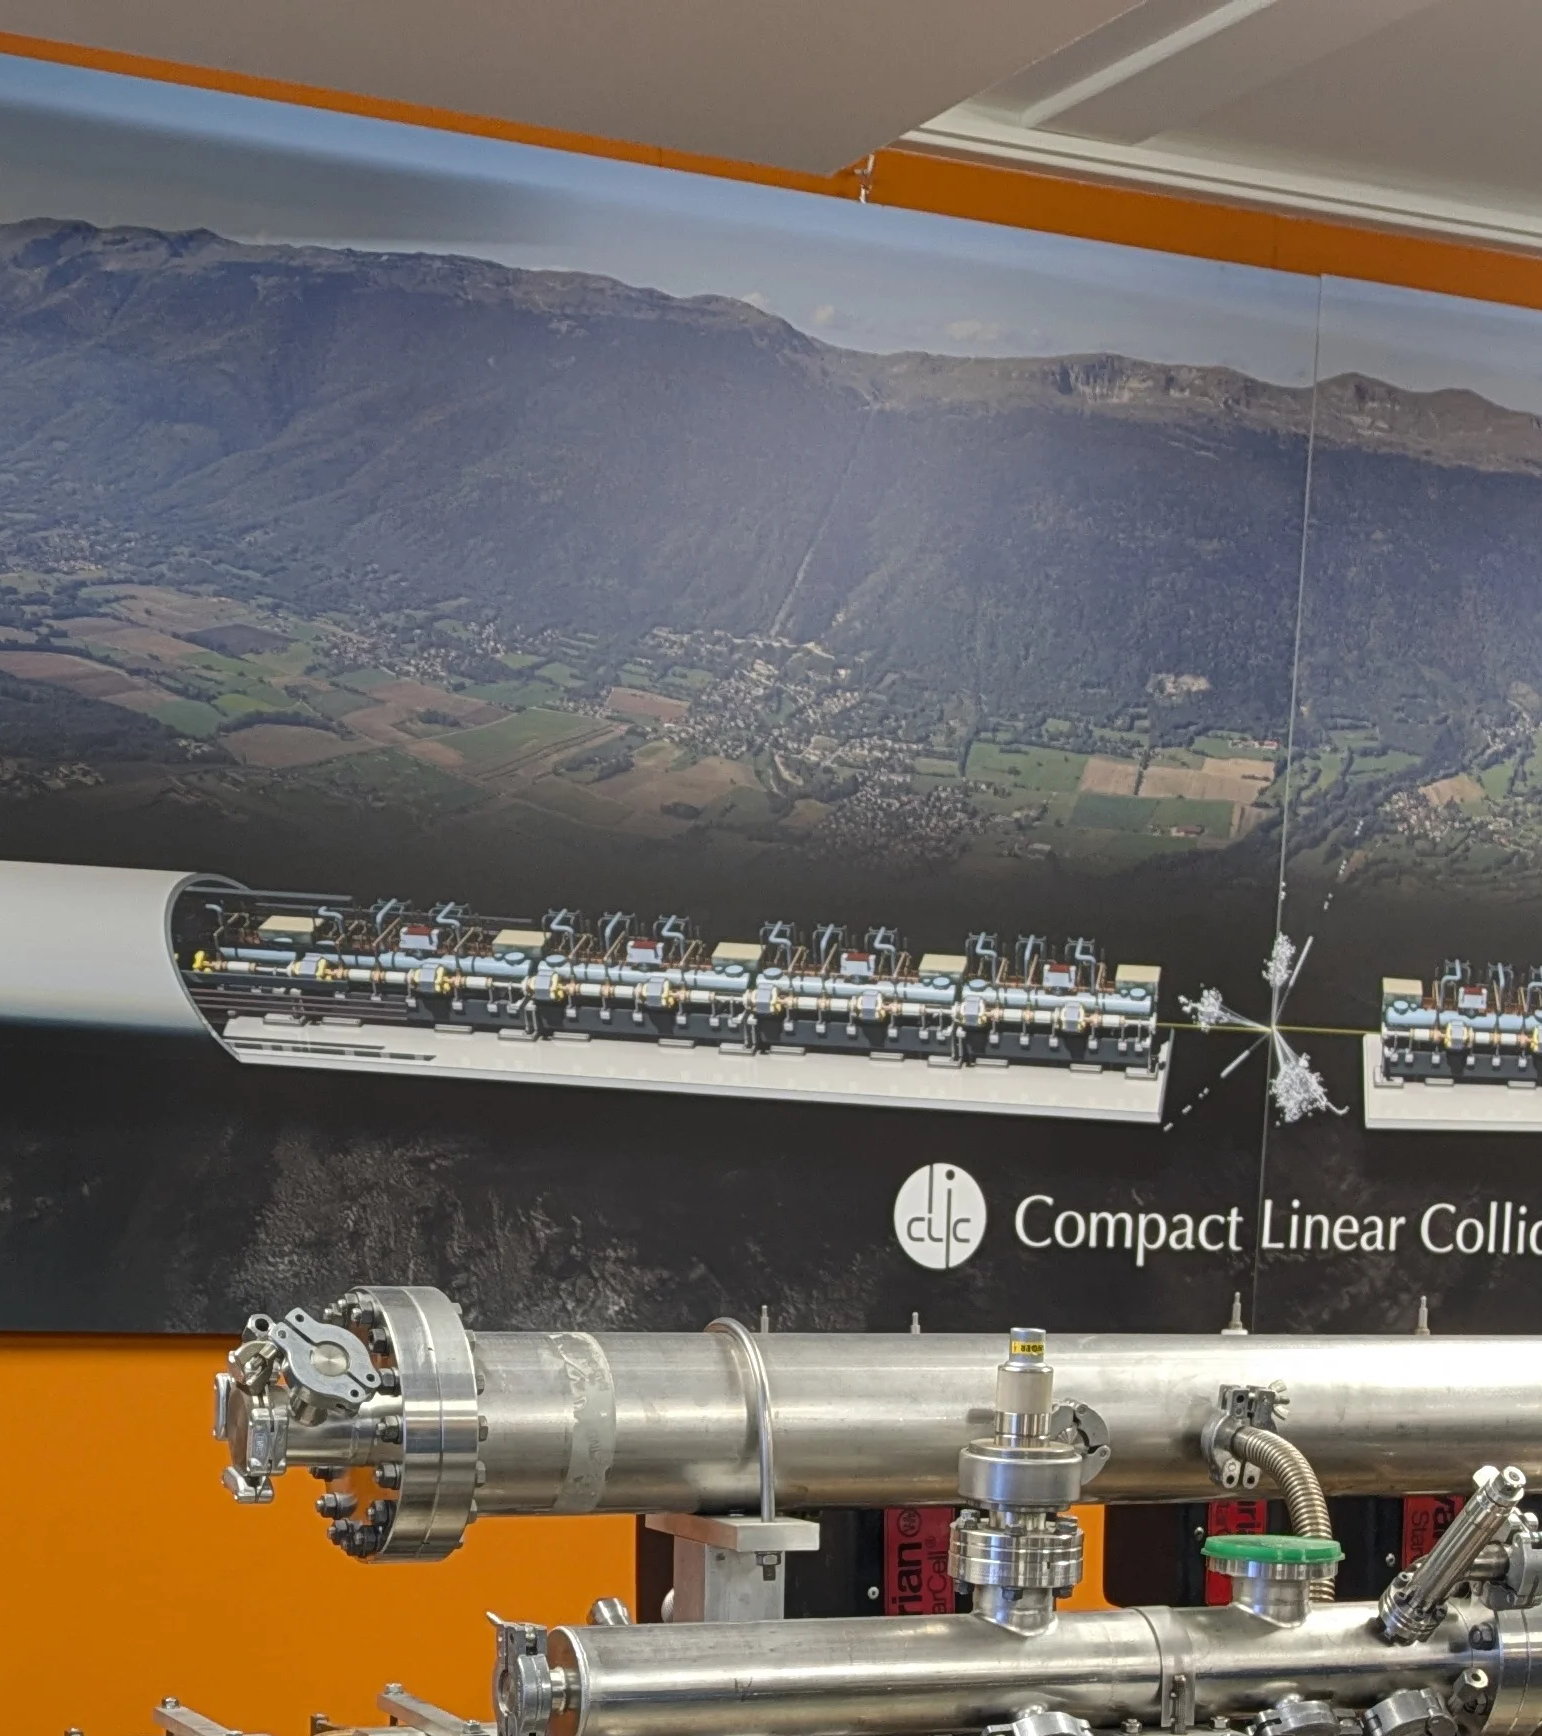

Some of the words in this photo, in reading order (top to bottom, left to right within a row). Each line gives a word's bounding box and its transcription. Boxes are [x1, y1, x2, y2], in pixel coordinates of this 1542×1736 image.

[1014, 1194, 1243, 1266] Compact
[1260, 1199, 1407, 1253] Linear
[891, 1541, 922, 1615] rian
